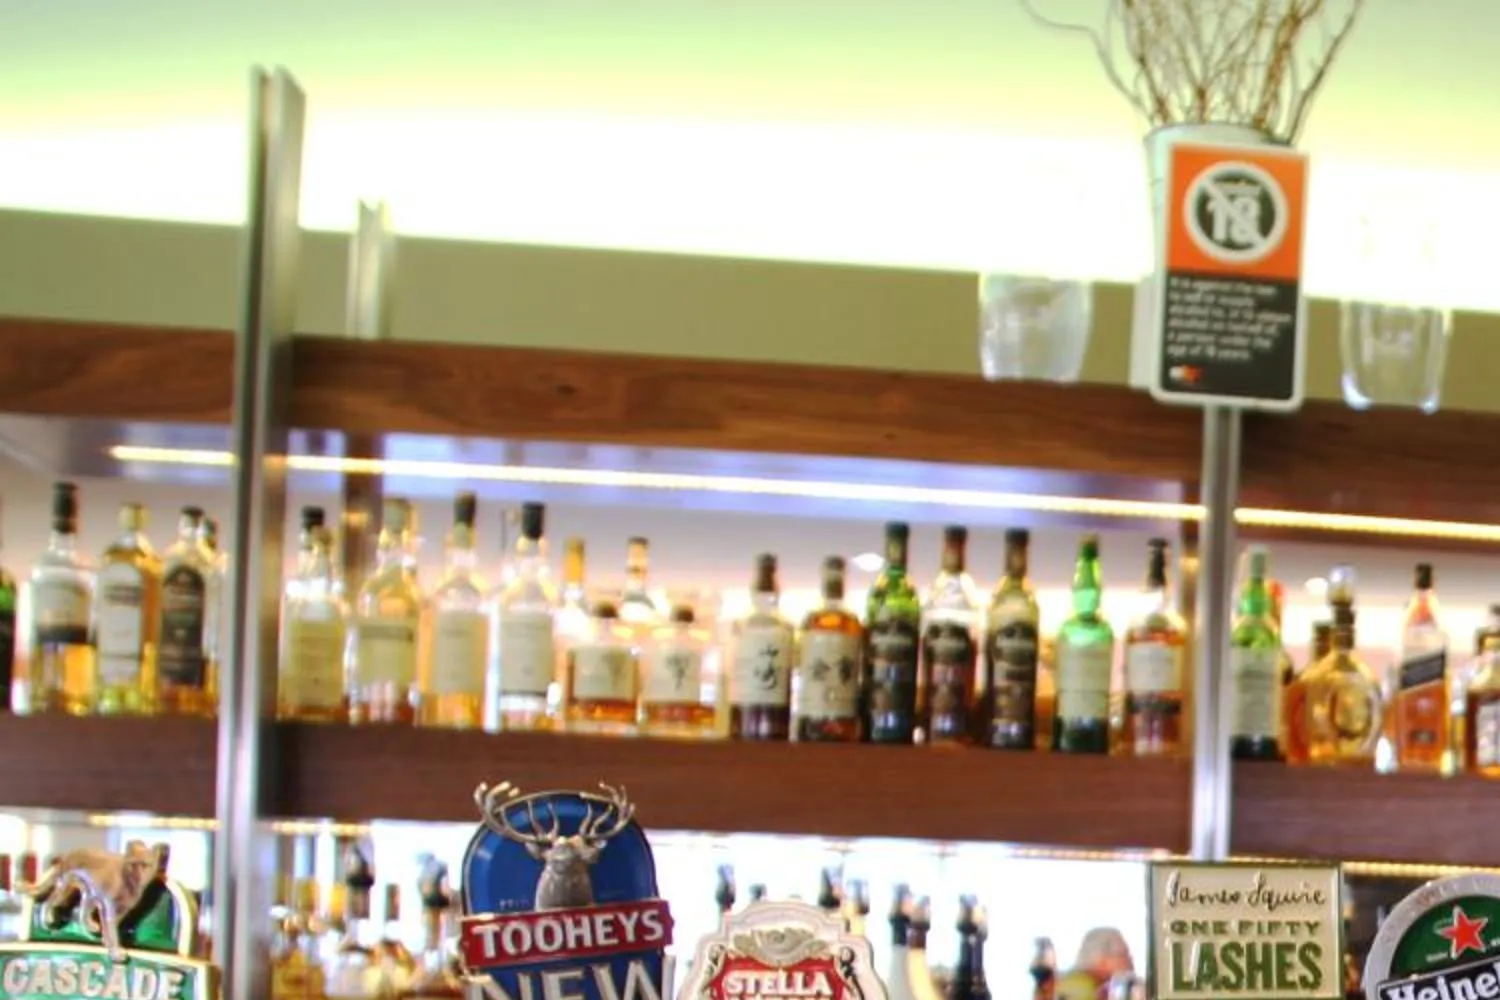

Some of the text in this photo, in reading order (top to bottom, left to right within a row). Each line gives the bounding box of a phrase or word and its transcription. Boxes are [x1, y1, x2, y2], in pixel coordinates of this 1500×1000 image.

[1166, 870, 1327, 911] James Squire
[472, 908, 665, 959] TOOHEYS
[1170, 919, 1322, 936] ONE FIFTY
[725, 970, 832, 996] STELLA
[1171, 940, 1324, 992] LASHES
